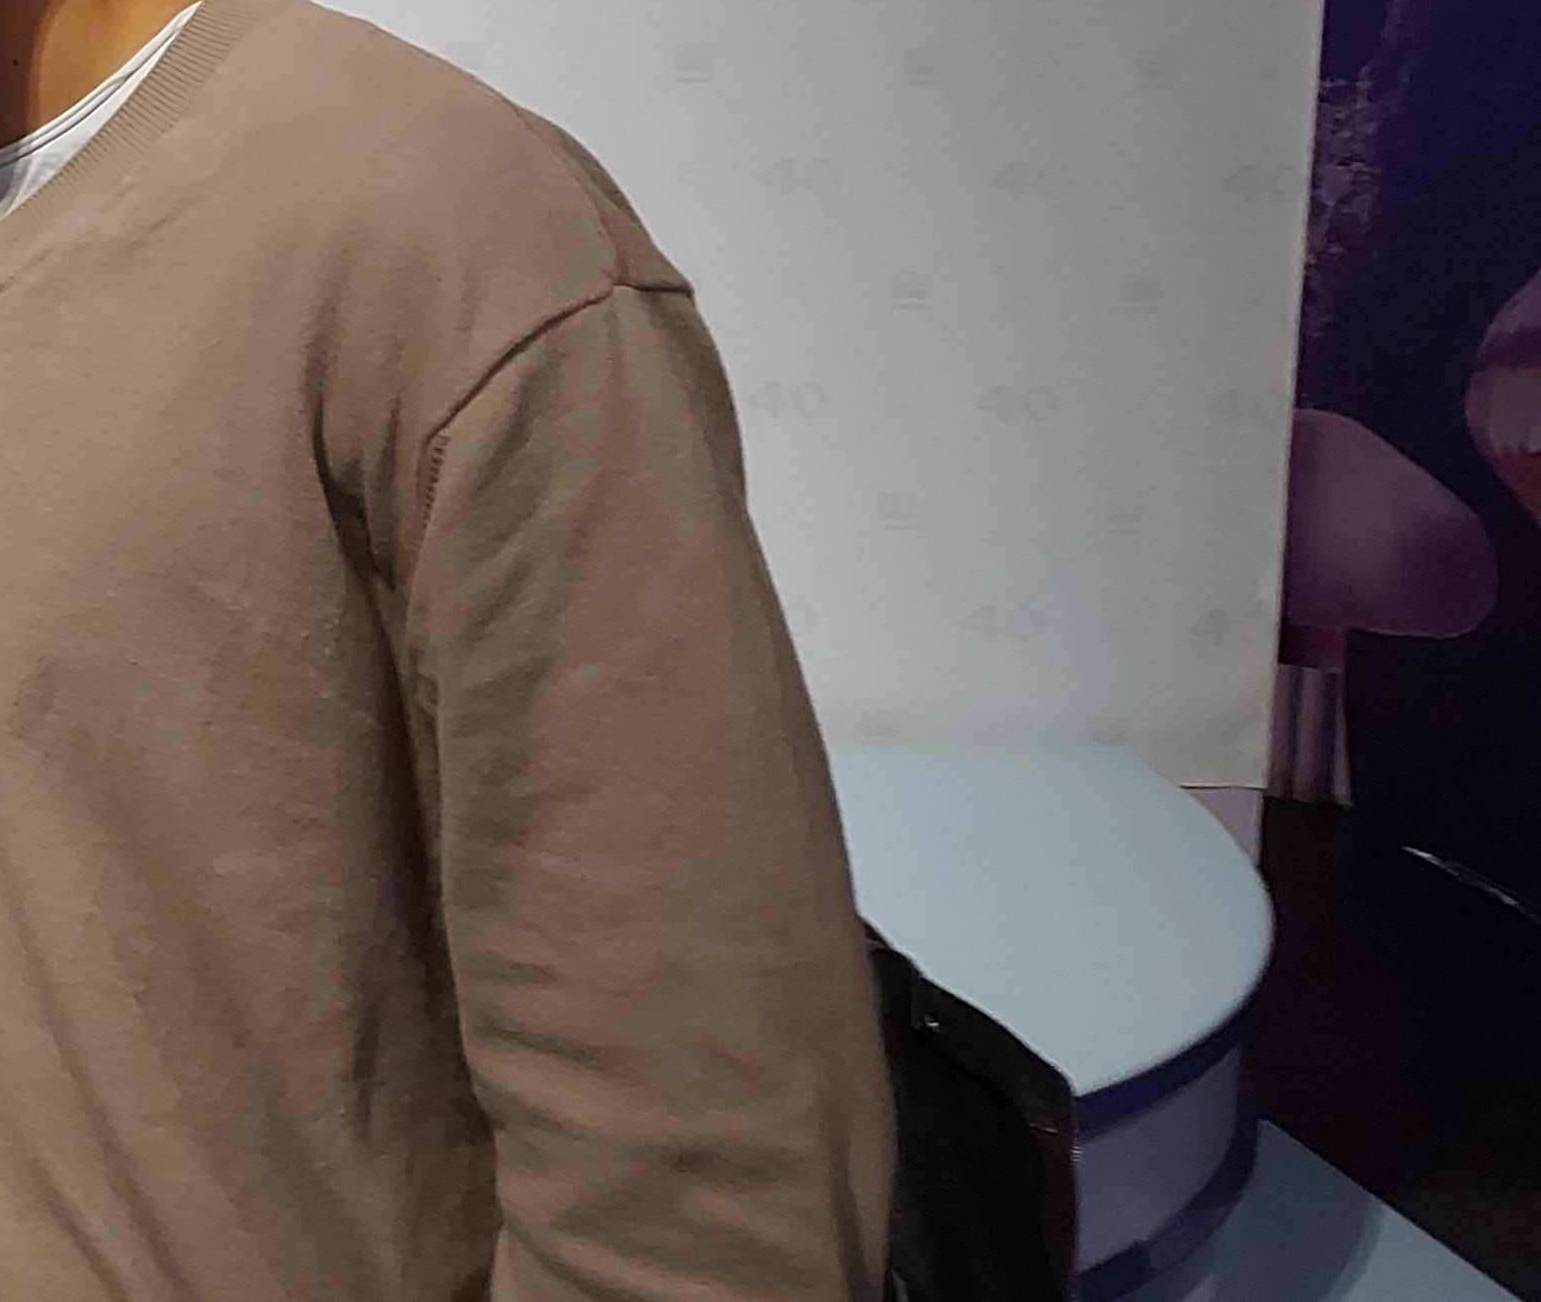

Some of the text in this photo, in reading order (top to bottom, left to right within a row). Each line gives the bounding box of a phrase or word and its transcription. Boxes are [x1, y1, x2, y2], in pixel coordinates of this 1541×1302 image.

[759, 155, 843, 196] 40
[989, 159, 1073, 200] 40
[751, 380, 833, 419] 40
[976, 381, 1060, 422] 40
[961, 601, 1045, 642] 40
